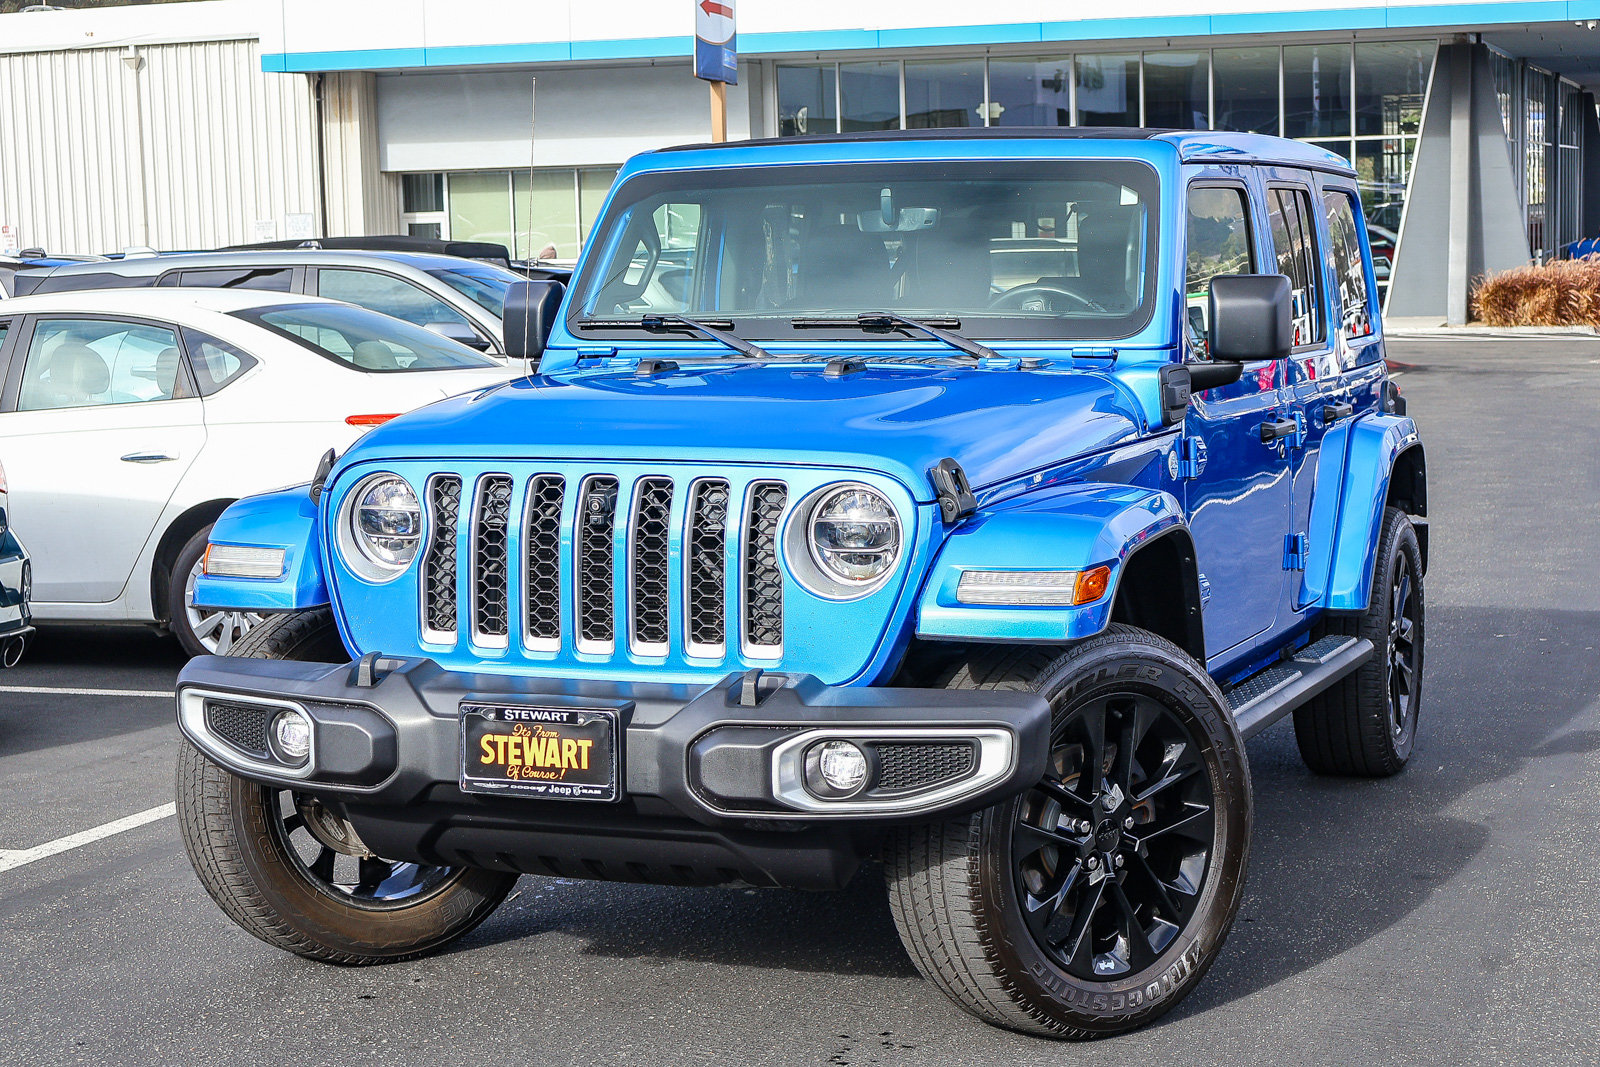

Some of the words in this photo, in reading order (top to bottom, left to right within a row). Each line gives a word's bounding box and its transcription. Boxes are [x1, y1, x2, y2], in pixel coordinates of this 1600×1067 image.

[504, 709, 570, 722] STEWART
[512, 723, 532, 737] It's
[533, 725, 561, 738] From
[480, 733, 593, 770] STEWART
[506, 764, 520, 780] Of
[549, 785, 572, 796] Jeep
